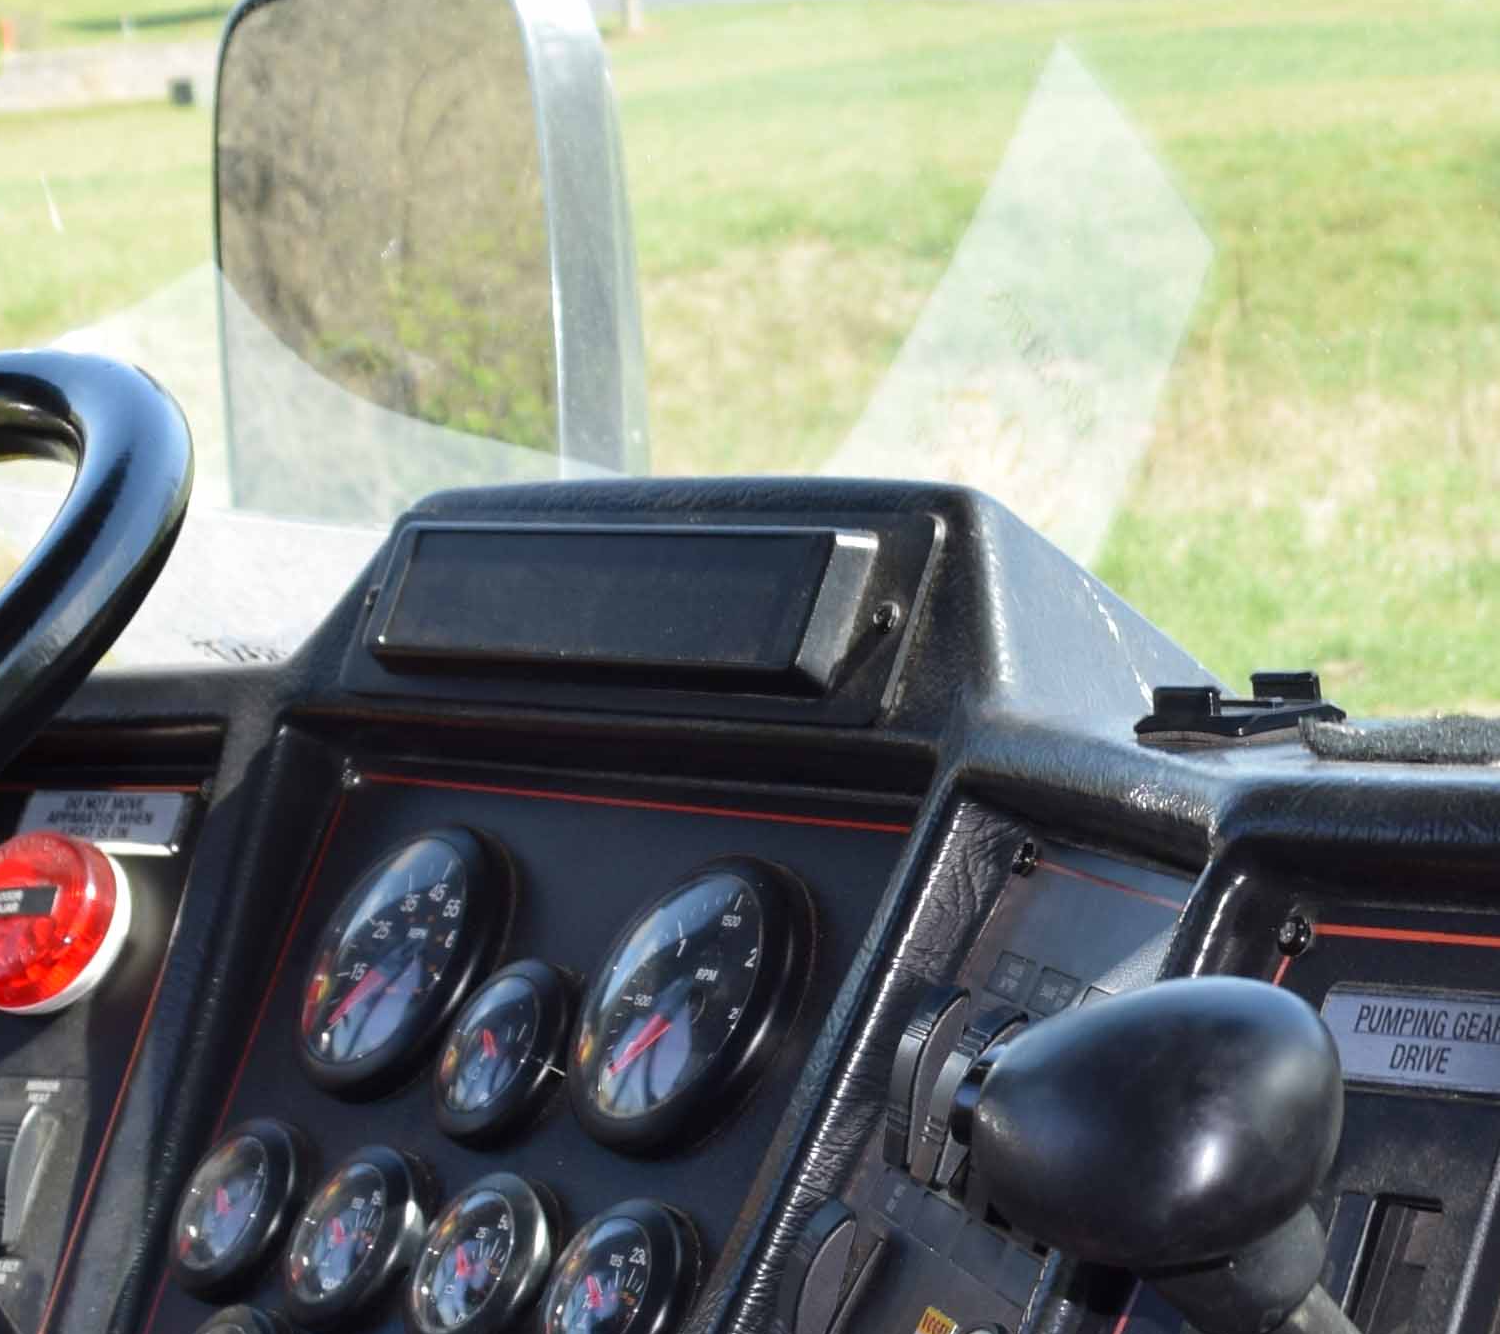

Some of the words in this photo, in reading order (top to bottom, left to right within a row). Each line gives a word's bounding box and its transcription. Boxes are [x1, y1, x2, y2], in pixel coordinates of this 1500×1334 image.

[695, 968, 719, 981] RPM
[1354, 1004, 1449, 1040] PUMPING
[1389, 1043, 1452, 1074] DRIVE
